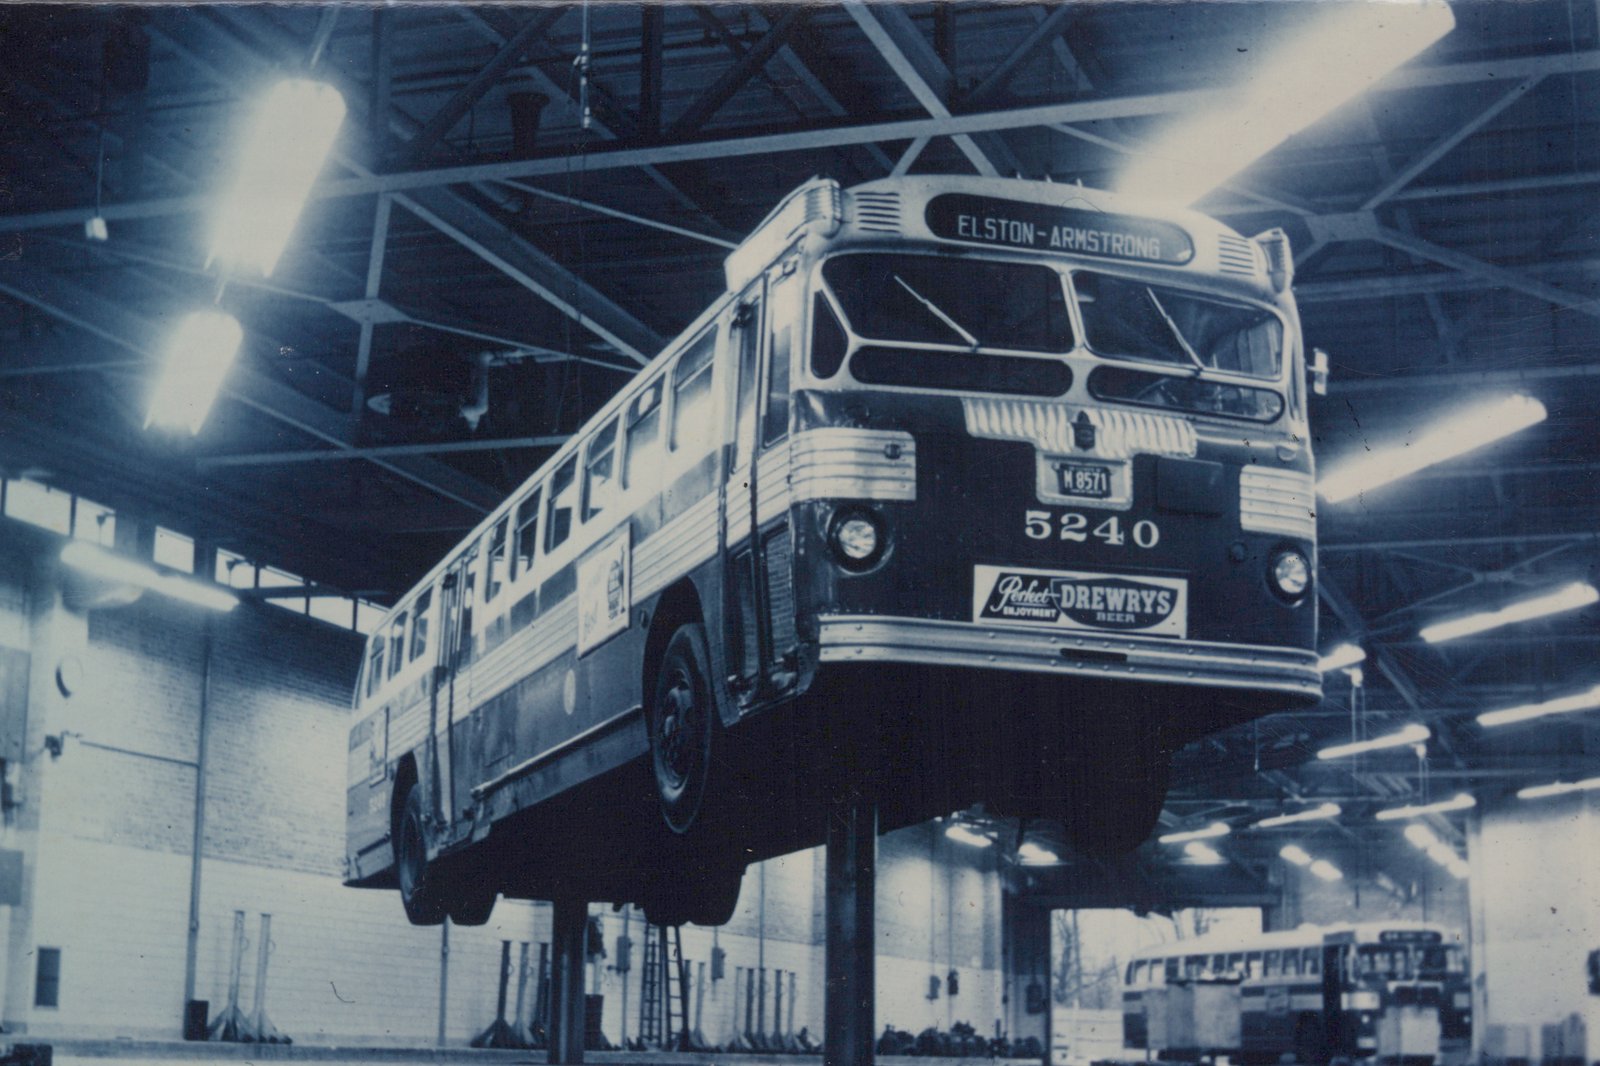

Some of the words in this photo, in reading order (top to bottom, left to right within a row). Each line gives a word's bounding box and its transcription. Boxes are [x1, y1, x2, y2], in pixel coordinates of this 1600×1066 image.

[1076, 471, 1107, 491] 8571
[1025, 510, 1159, 548] 5240
[990, 576, 1058, 612] Perfect
[1060, 584, 1171, 615] DREWRYS
[1003, 606, 1056, 618] ENJOYMENT
[1096, 611, 1135, 623] BEER
